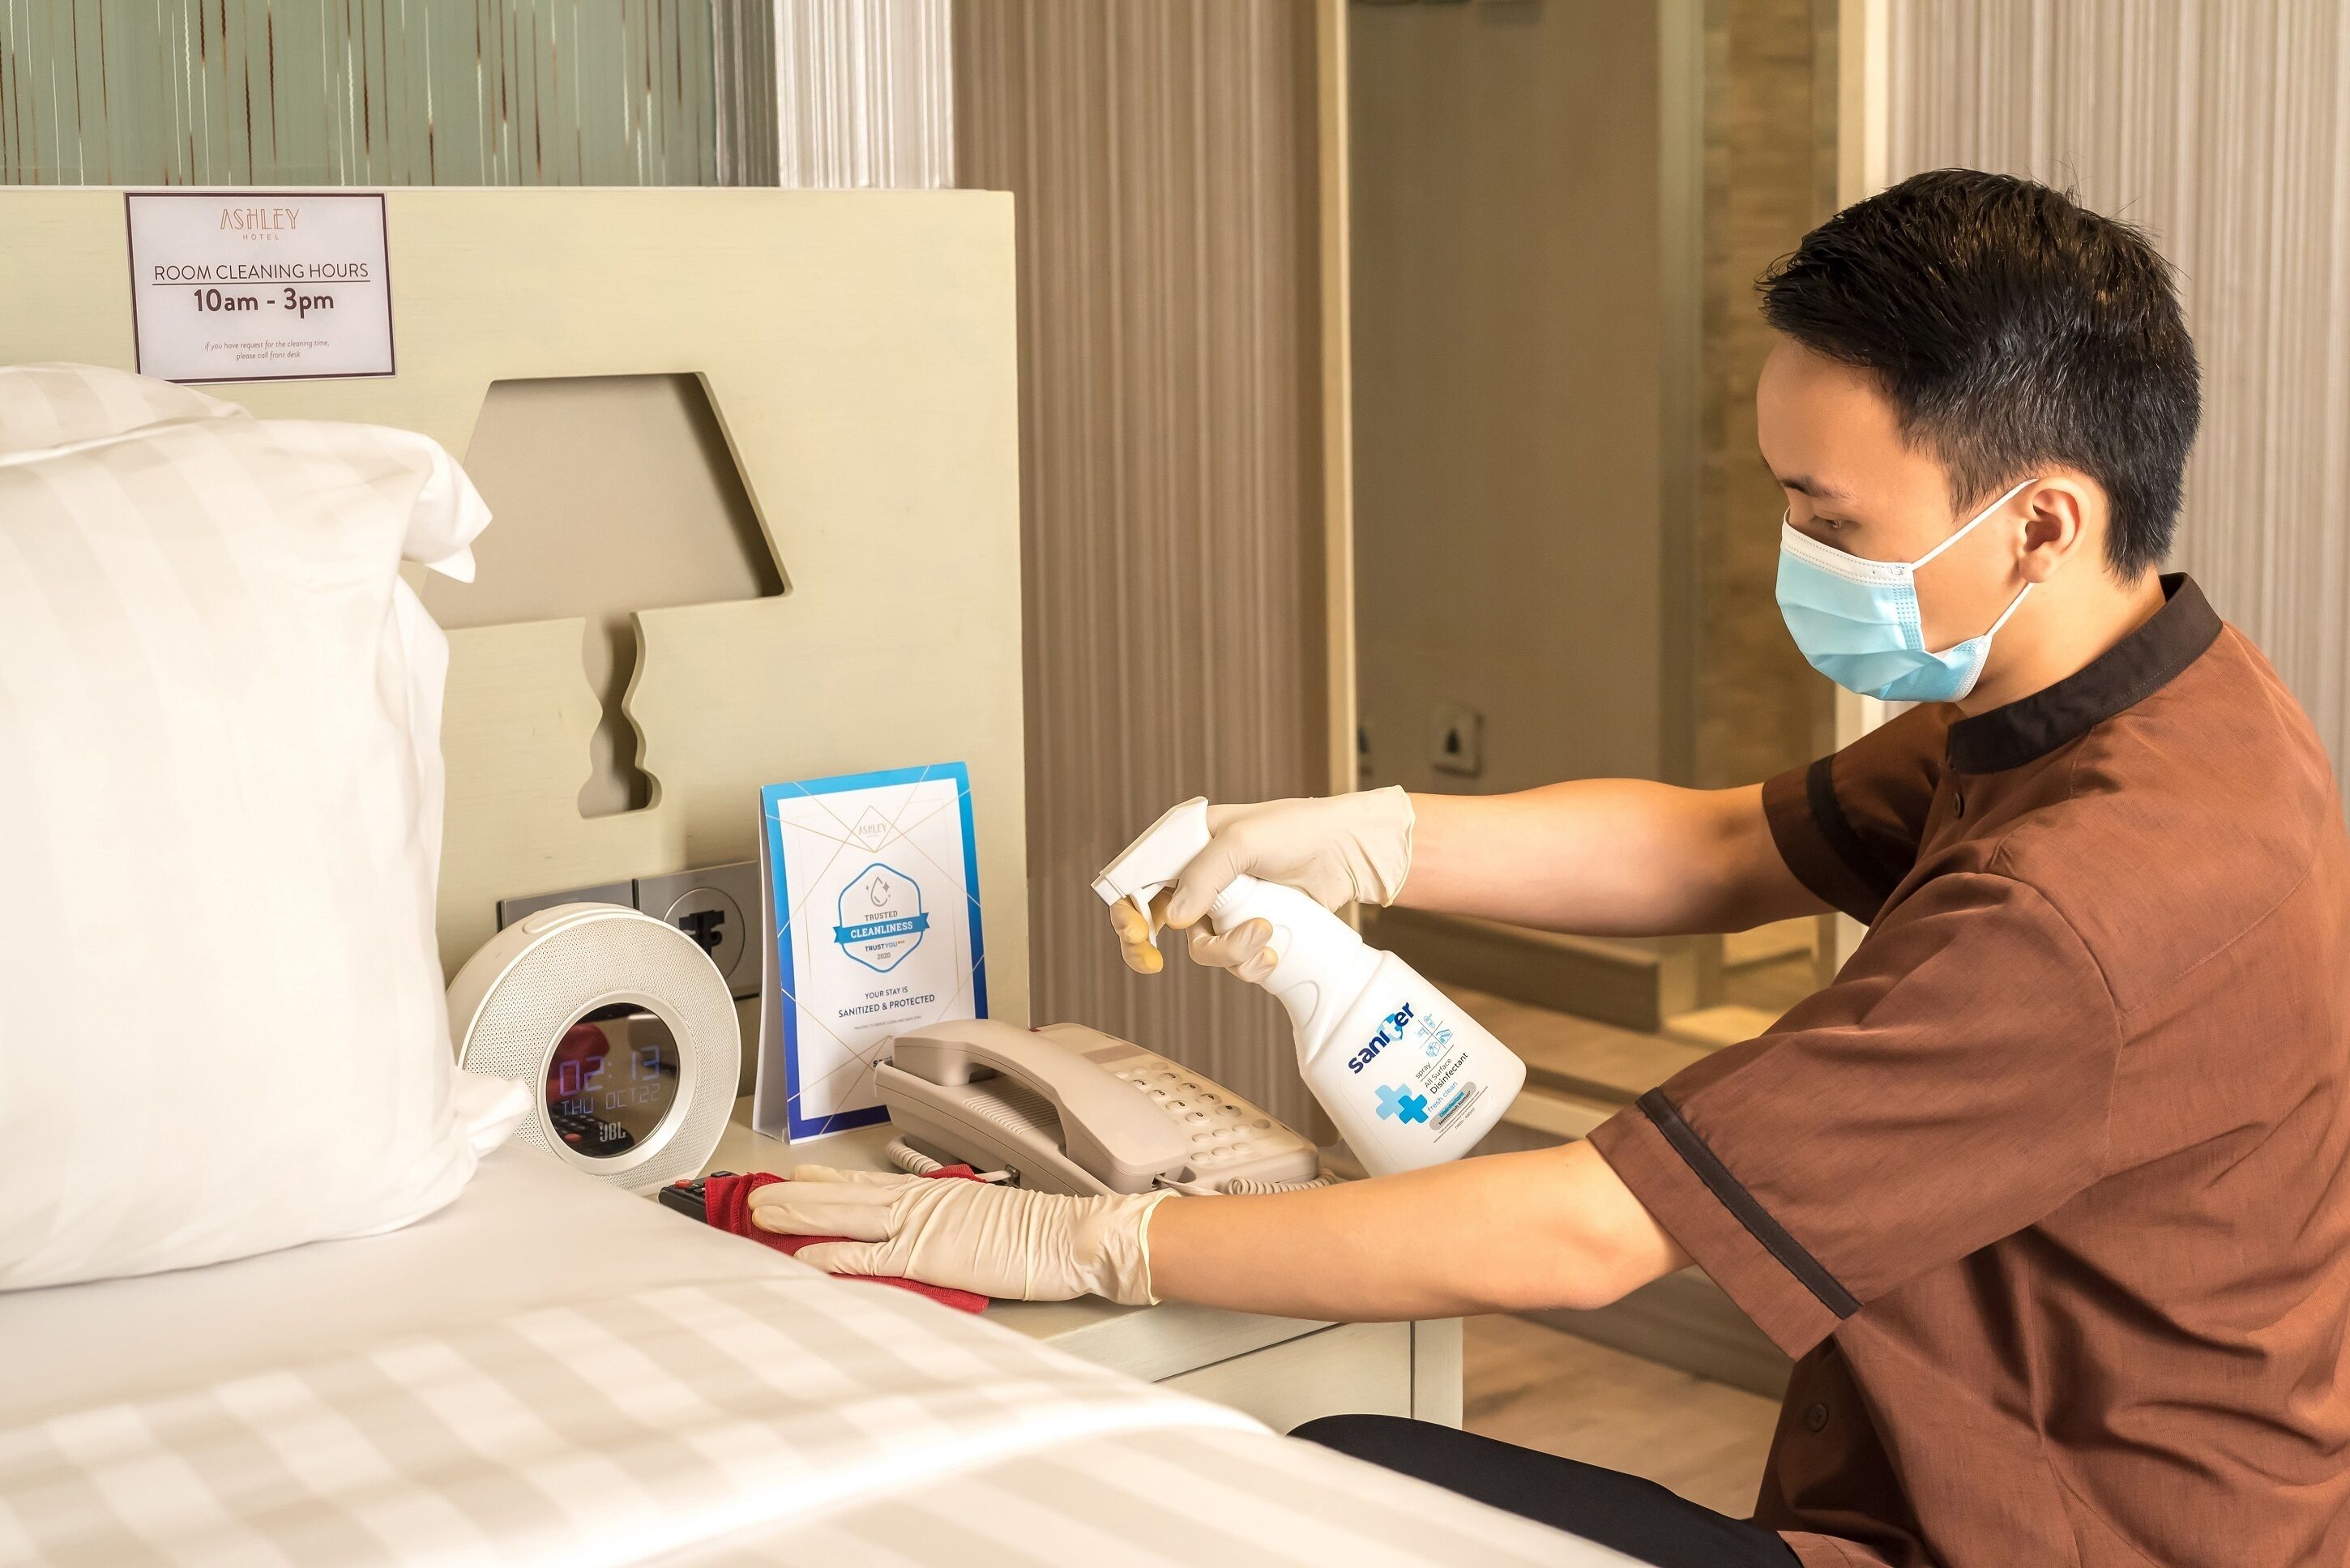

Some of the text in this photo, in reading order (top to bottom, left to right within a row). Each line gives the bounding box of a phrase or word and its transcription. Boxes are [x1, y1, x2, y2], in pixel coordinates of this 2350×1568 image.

[220, 208, 300, 230] ASHLEY
[154, 263, 369, 280] ROOM CLEANING HOURS
[194, 288, 258, 312] 10am
[283, 287, 334, 319] 3pm
[204, 340, 210, 352] if
[211, 343, 223, 352] you
[224, 341, 239, 349] have
[240, 341, 263, 351] request
[264, 340, 274, 350] for
[287, 339, 313, 349] cleaning
[314, 339, 330, 348] time,
[236, 350, 301, 361] please call front desk
[859, 822, 887, 835] ASHLEY
[865, 910, 898, 921] TRUSTED
[850, 921, 913, 938] CLEANLINESS
[865, 941, 898, 952] TRUSTYOU
[877, 952, 891, 960] 2020
[865, 990, 884, 1000] YOUR
[886, 988, 901, 997] STAY
[839, 994, 935, 1018] SANITIZED & PROTECTED
[1415, 1062, 1431, 1079] spray
[1425, 1058, 1452, 1088] All Surface
[1429, 1053, 1468, 1095] Disinfectant
[561, 1096, 594, 1116] THU
[1427, 1082, 1459, 1113] fresh clean
[600, 1122, 626, 1143] JBL
